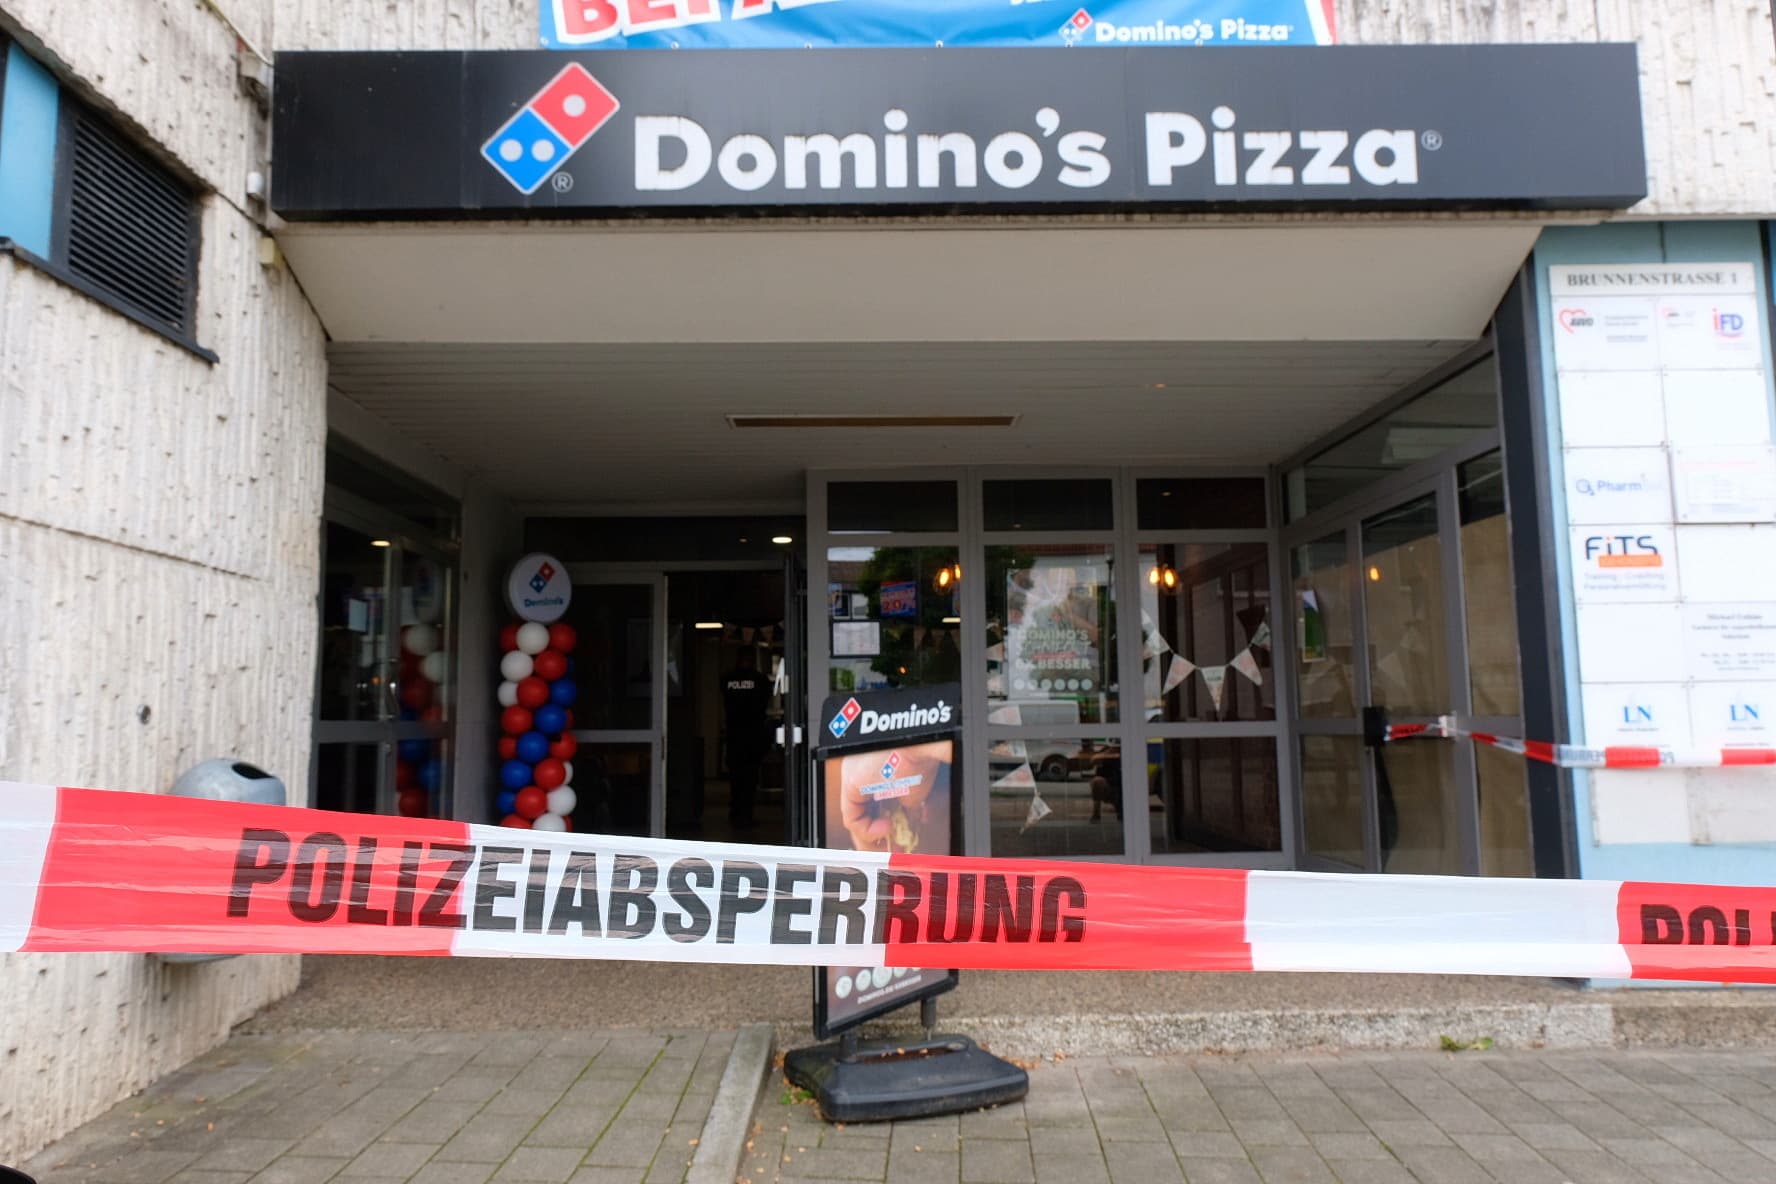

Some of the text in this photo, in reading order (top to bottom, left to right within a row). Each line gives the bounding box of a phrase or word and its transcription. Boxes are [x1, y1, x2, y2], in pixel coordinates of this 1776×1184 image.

[1095, 18, 1289, 42] Domino's Pizza
[634, 105, 1418, 191] Domino's Pizza
[1566, 271, 1727, 288] BRUNNENSTRASSE
[727, 679, 755, 690] POLIZEI
[859, 699, 952, 735] Domino's
[226, 827, 1088, 945] POLIZEIABSPERRUNG
